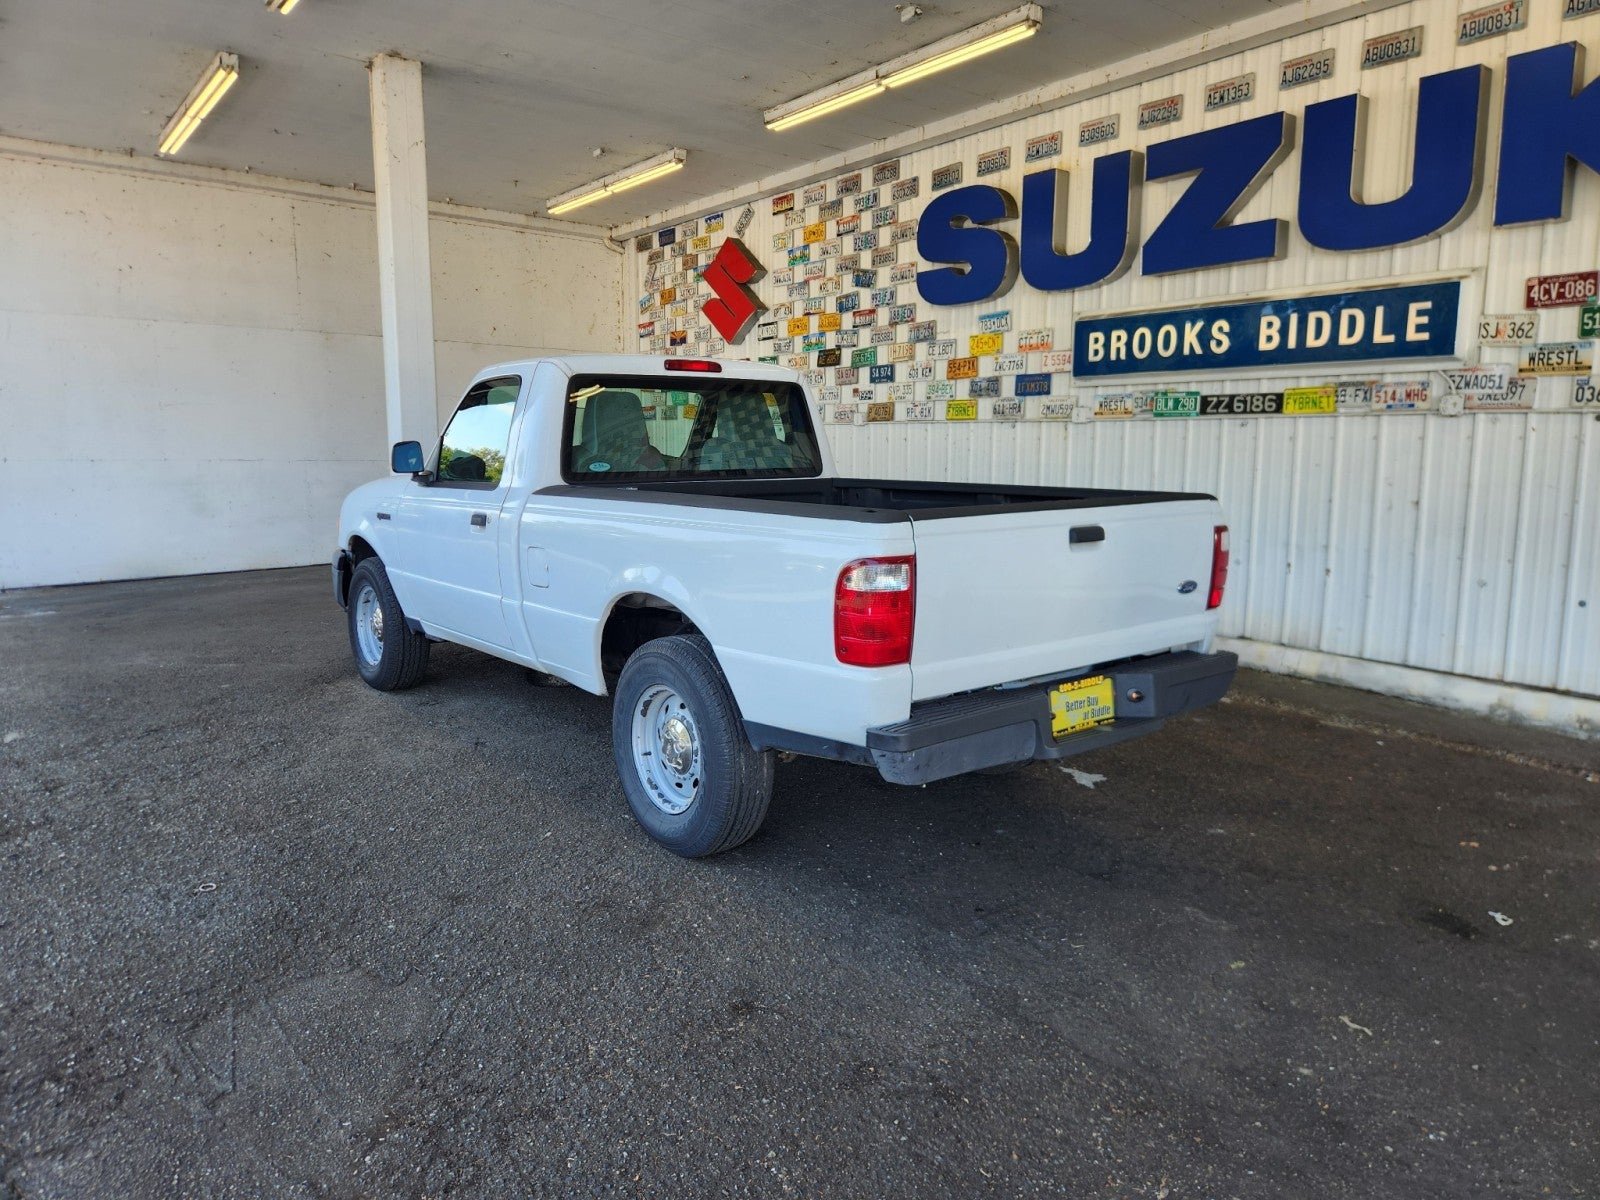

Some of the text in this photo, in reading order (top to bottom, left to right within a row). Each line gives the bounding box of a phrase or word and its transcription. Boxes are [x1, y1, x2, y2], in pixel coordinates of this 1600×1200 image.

[1460, 8, 1519, 39] ABU0831
[1364, 36, 1416, 64] ABU0831
[1281, 58, 1330, 85] AJG2295
[1207, 82, 1250, 107] AEW1353
[1530, 279, 1596, 302] 4CV-086
[1088, 301, 1433, 362] BROOKS BIDDLE
[1508, 321, 1535, 340] 362
[1528, 350, 1584, 367] WRESTL
[872, 366, 891, 378] SA 974
[1206, 395, 1277, 413] ZZ 6186
[1405, 388, 1427, 402] MHG
[1179, 397, 1195, 412] 298
[1065, 695, 1099, 712] Better Buy
[1091, 704, 1111, 719] Biddle
